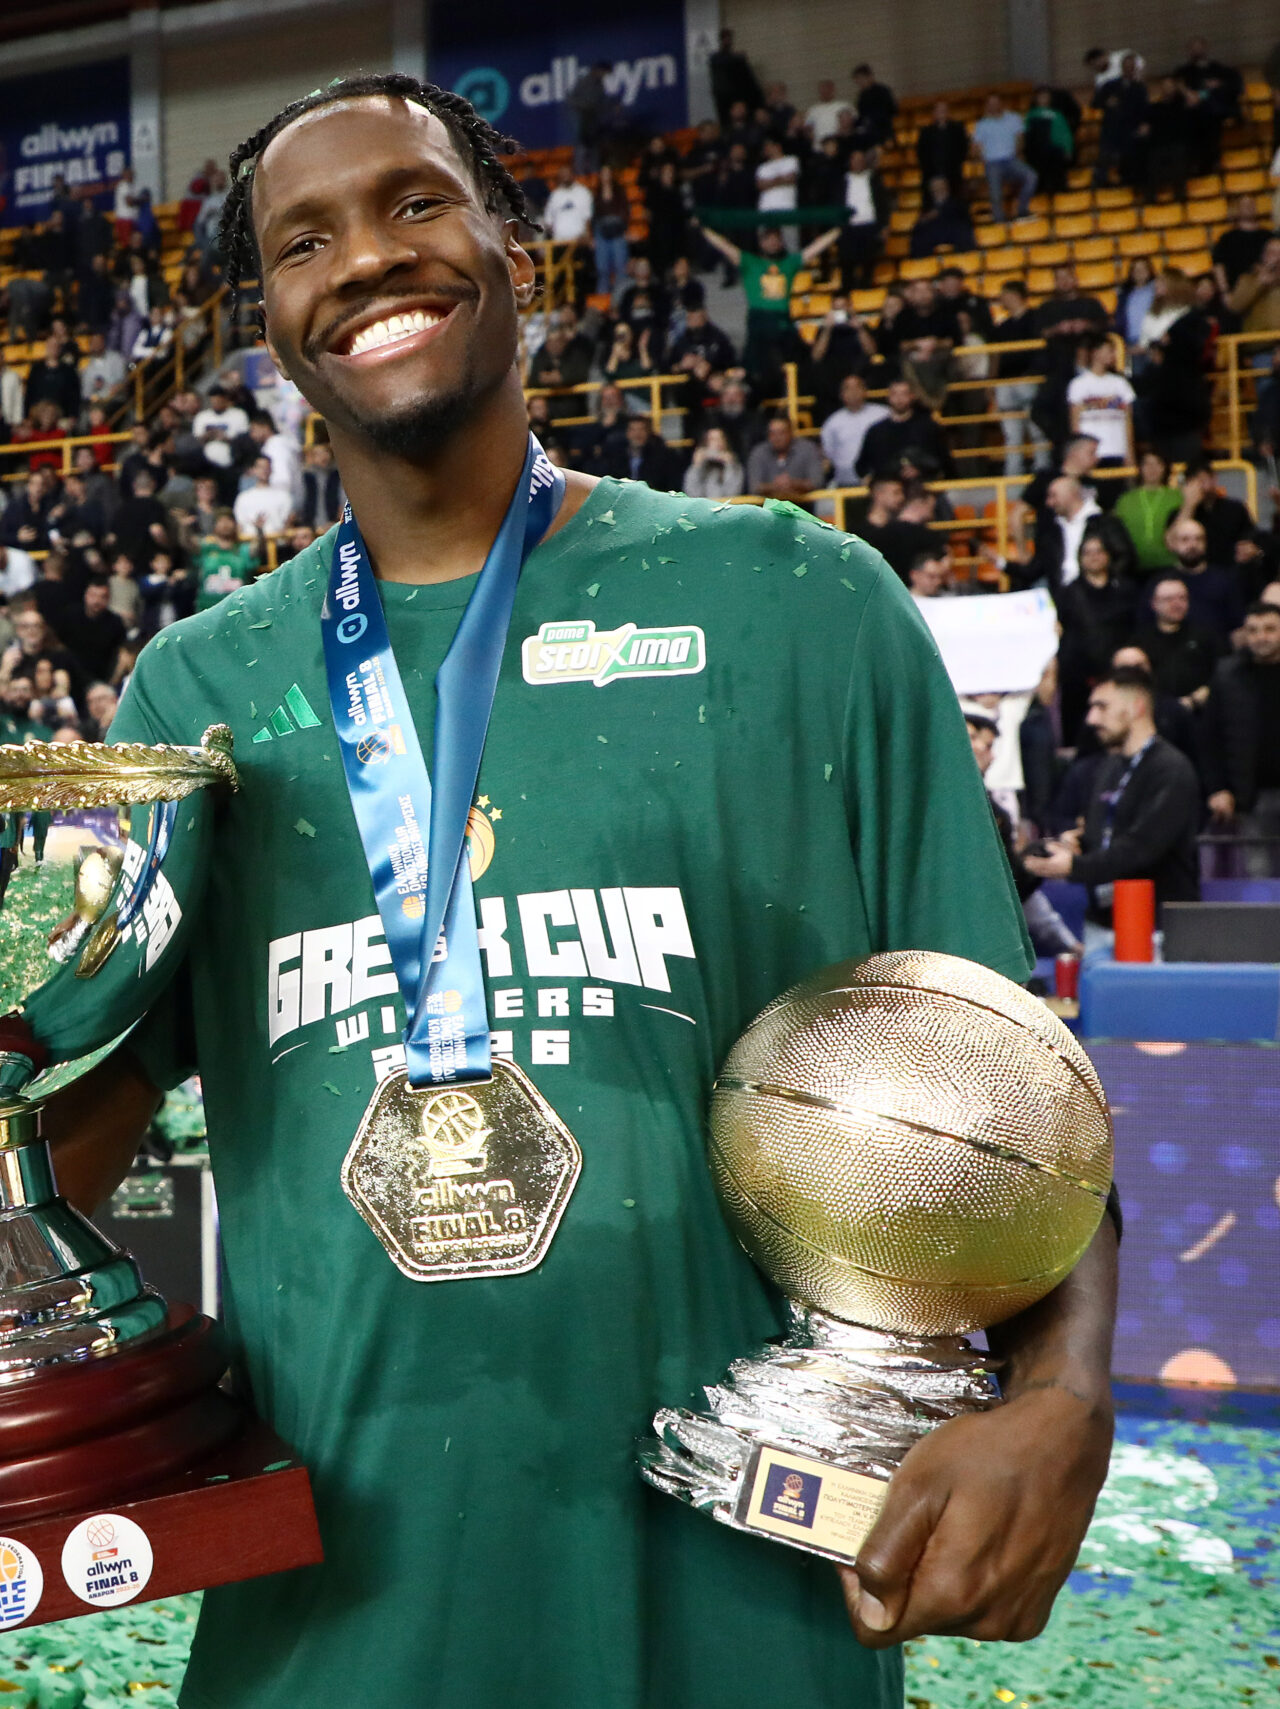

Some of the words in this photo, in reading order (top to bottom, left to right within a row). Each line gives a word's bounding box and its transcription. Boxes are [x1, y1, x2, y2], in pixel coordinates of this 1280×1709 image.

[22, 121, 118, 157] allwyn
[14, 157, 102, 193] FINAL
[336, 540, 362, 611] allwyn
[545, 627, 587, 642] pame
[358, 659, 373, 674] 8
[345, 671, 368, 727] allwyn
[362, 672, 388, 725] FINAL
[387, 843, 410, 895] ΕΛΛΗΝΙΚΗ
[269, 895, 513, 1048] GREK
[517, 887, 696, 993] CUP
[336, 987, 614, 1047] WIERS
[450, 1014, 468, 1069] ΕΛΛΗΝΙΚΗ
[410, 1211, 502, 1241] FINAL
[85, 1574, 128, 1593] FINAL
[129, 1571, 139, 1583] 8
[86, 1558, 133, 1577] allwyn
